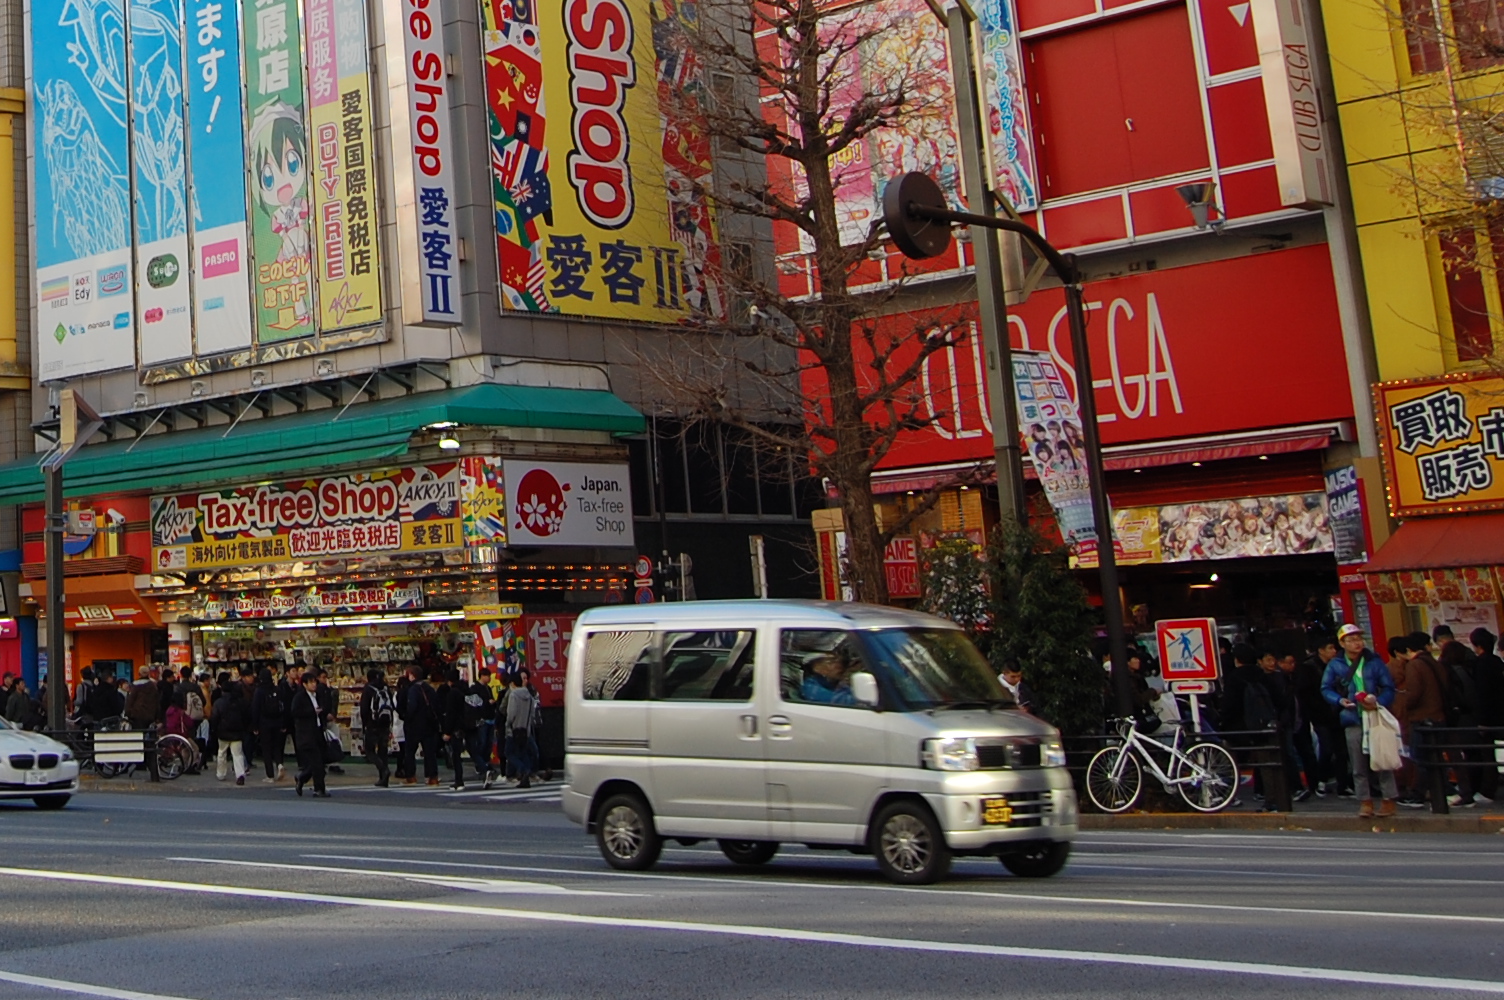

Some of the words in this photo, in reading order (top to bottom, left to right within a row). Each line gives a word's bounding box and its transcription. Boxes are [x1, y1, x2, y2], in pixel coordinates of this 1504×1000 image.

[1284, 44, 1314, 95] SEGA
[411, 53, 442, 177] Shop
[1293, 100, 1321, 152] CLUB
[318, 123, 340, 198] DUTY
[323, 201, 345, 281] FREE
[204, 251, 236, 267] PASMO
[259, 256, 310, 284] このビル
[100, 270, 125, 284] WAON
[74, 287, 92, 301] Edy
[329, 282, 363, 324] AKKY
[1391, 389, 1472, 454] 買取
[581, 476, 623, 495] Japan.
[1325, 465, 1356, 493] MUSIC
[1417, 445, 1492, 501] 販売
[201, 490, 314, 530] Tax-free
[322, 482, 395, 518] Shop
[576, 497, 624, 513] Tax-free
[1329, 493, 1360, 518] GAME
[596, 518, 626, 535] Shop
[192, 538, 286, 564] 海外向け電気製品
[78, 605, 114, 621] Hey
[272, 596, 295, 609] Shop
